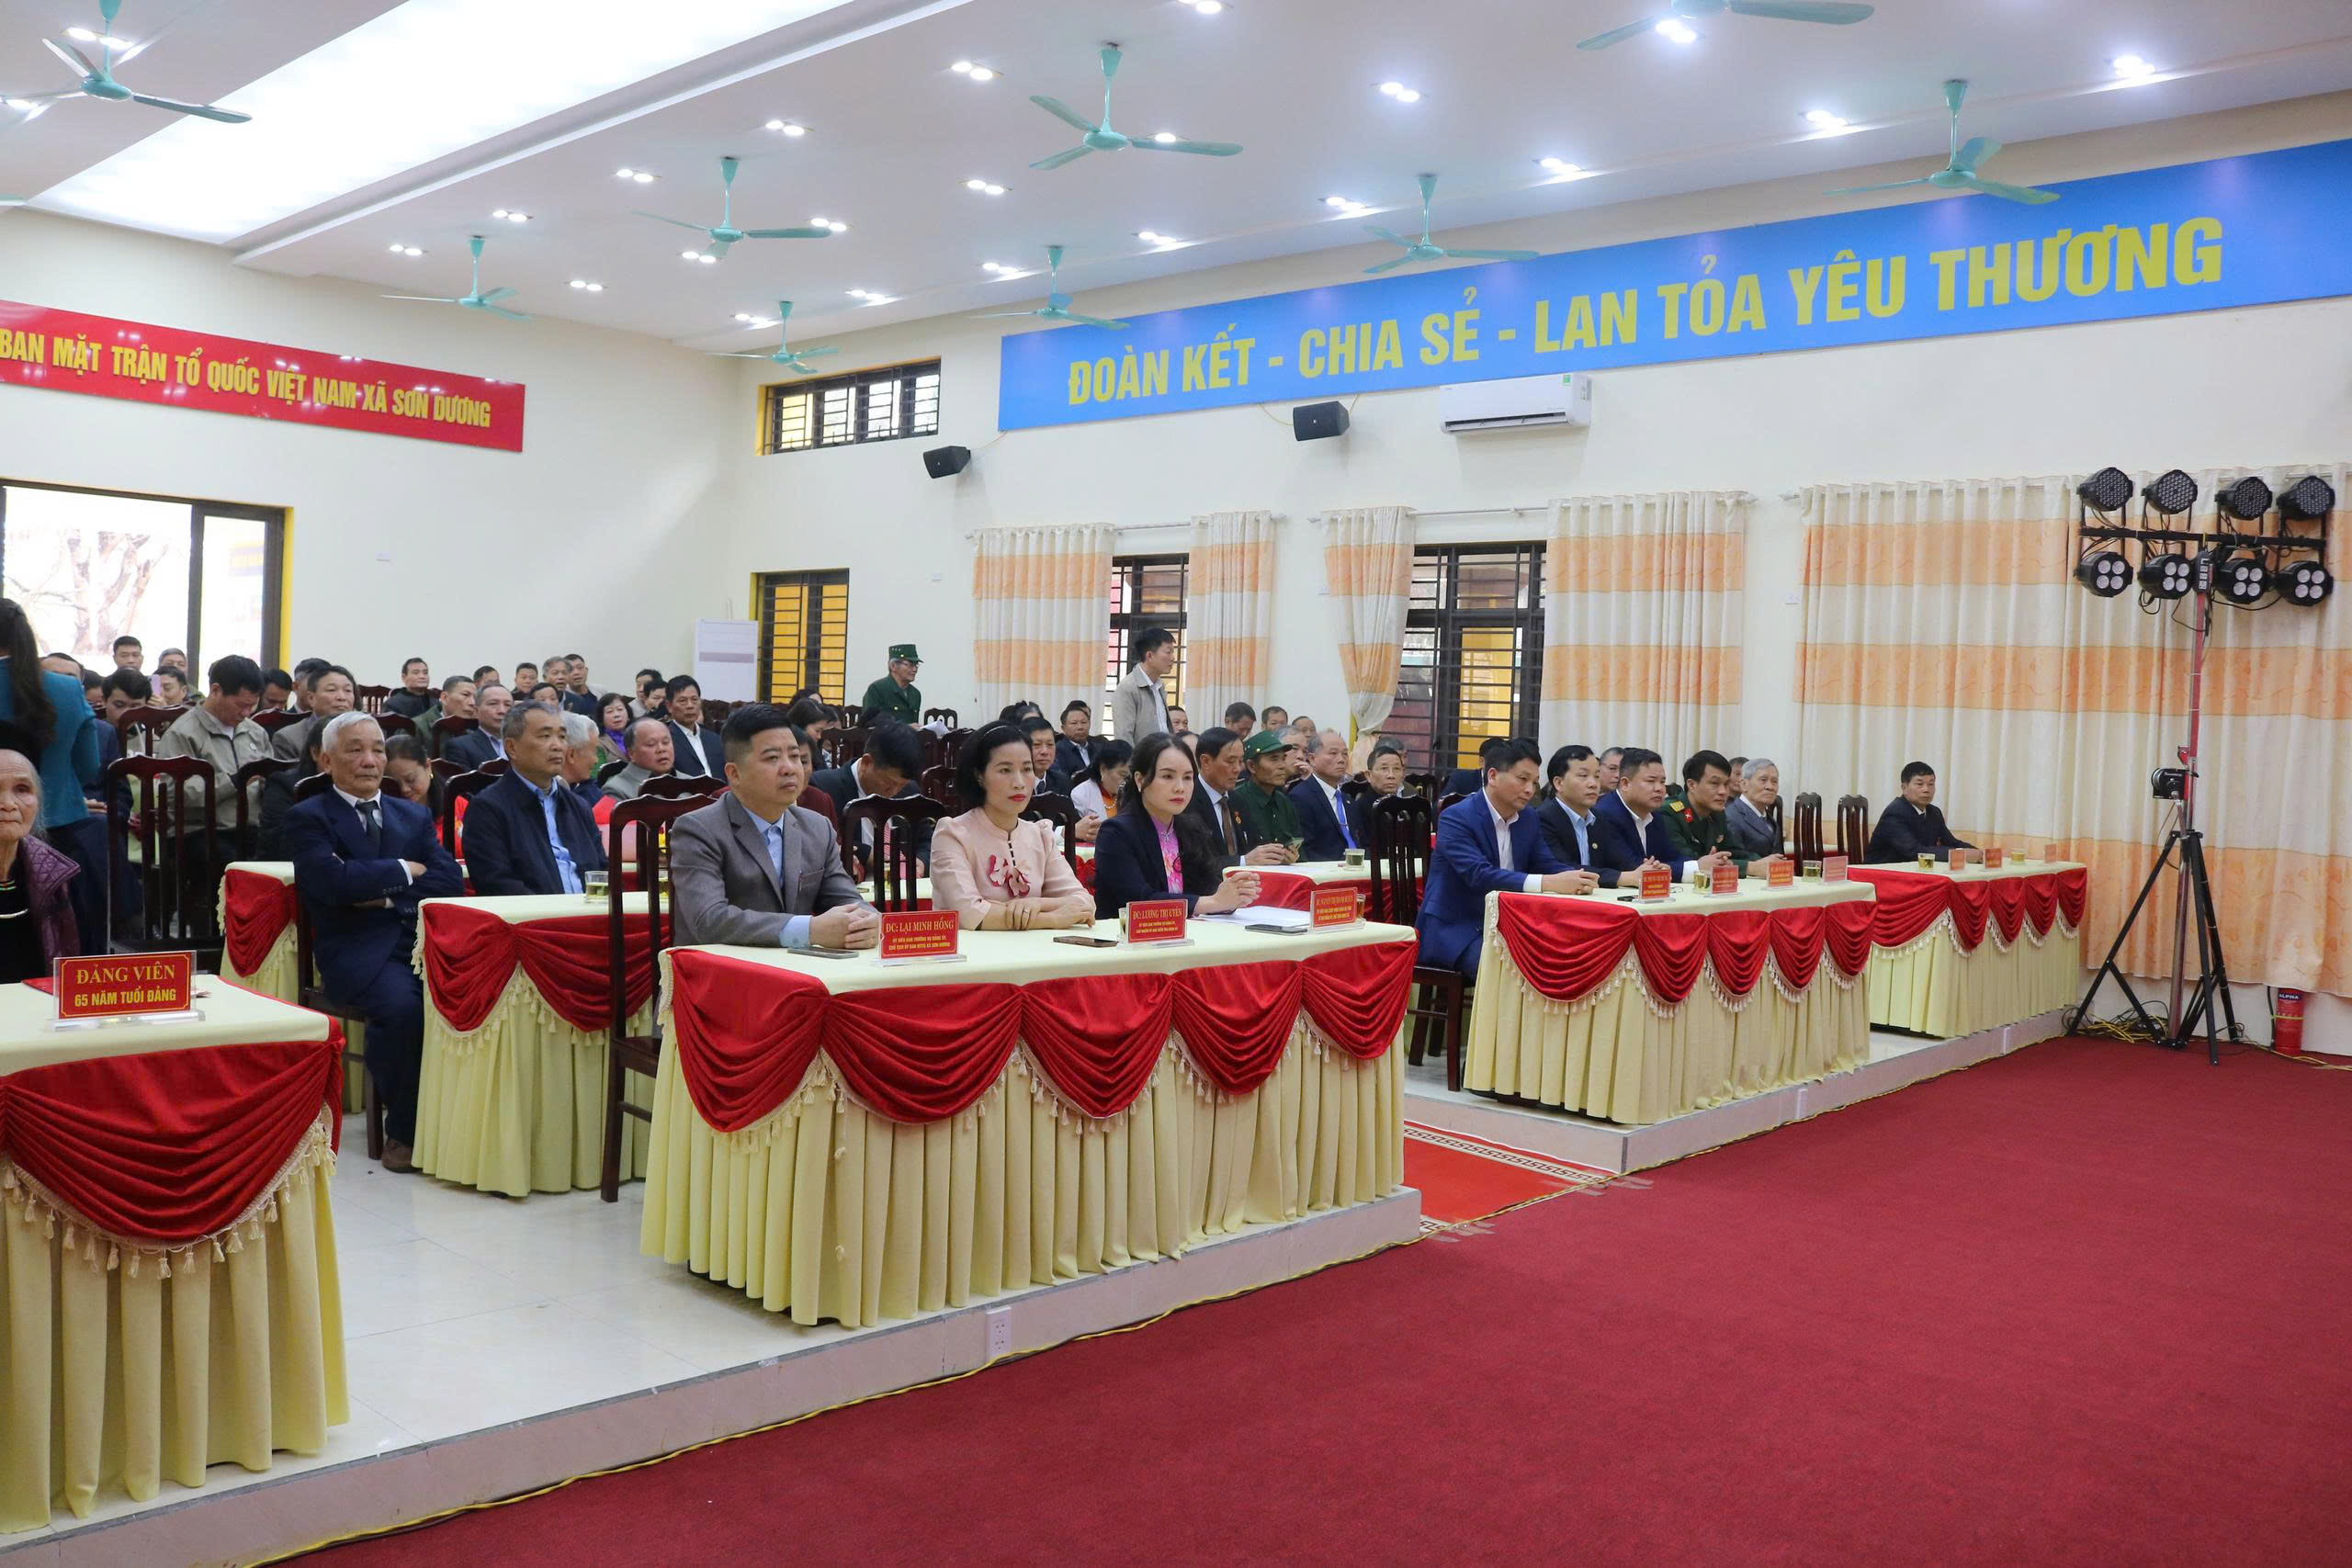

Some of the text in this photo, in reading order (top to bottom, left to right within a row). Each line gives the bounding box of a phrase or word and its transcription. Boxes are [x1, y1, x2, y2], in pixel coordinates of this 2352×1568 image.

[1068, 217, 2222, 405] ĐOÀN KẾT - CHIA SẺ - LAN TỎA YÊU THƯƠNG
[0, 328, 490, 428] BAN MẶT TRẬN TỔ QUỐC VIỆT NAM XÃ SƠN DƯƠNG
[900, 922, 911, 933] LẠI
[913, 921, 932, 931] MINH
[76, 961, 175, 984] ĐẢNG VIÊN
[74, 985, 176, 1007] 65 NĂM TUỔI ĐẢNG
